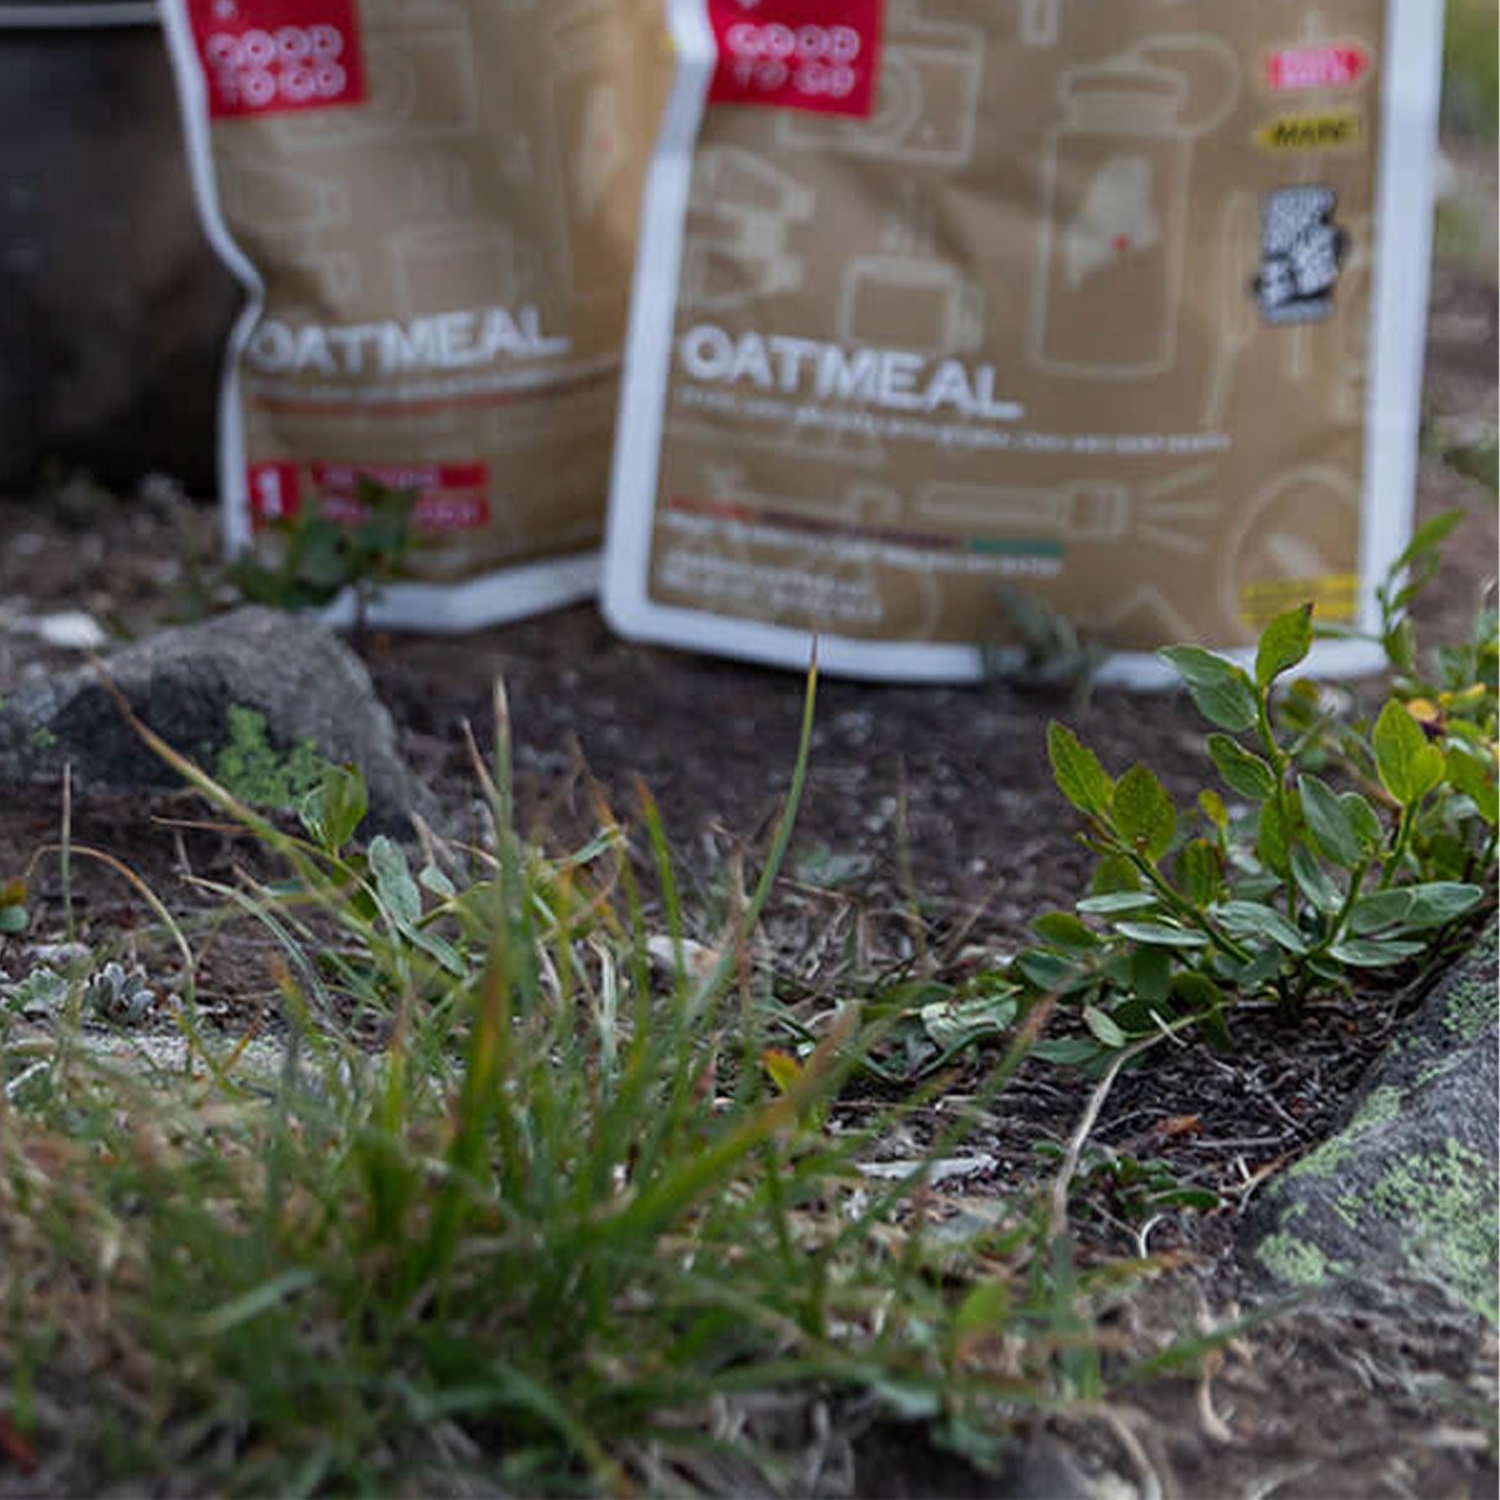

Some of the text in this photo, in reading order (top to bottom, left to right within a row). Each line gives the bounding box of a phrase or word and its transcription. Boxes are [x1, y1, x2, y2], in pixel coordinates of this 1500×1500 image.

[726, 22, 861, 62] GOOD
[248, 304, 572, 376] OATMEAL
[678, 323, 1025, 421] OATMEAL
